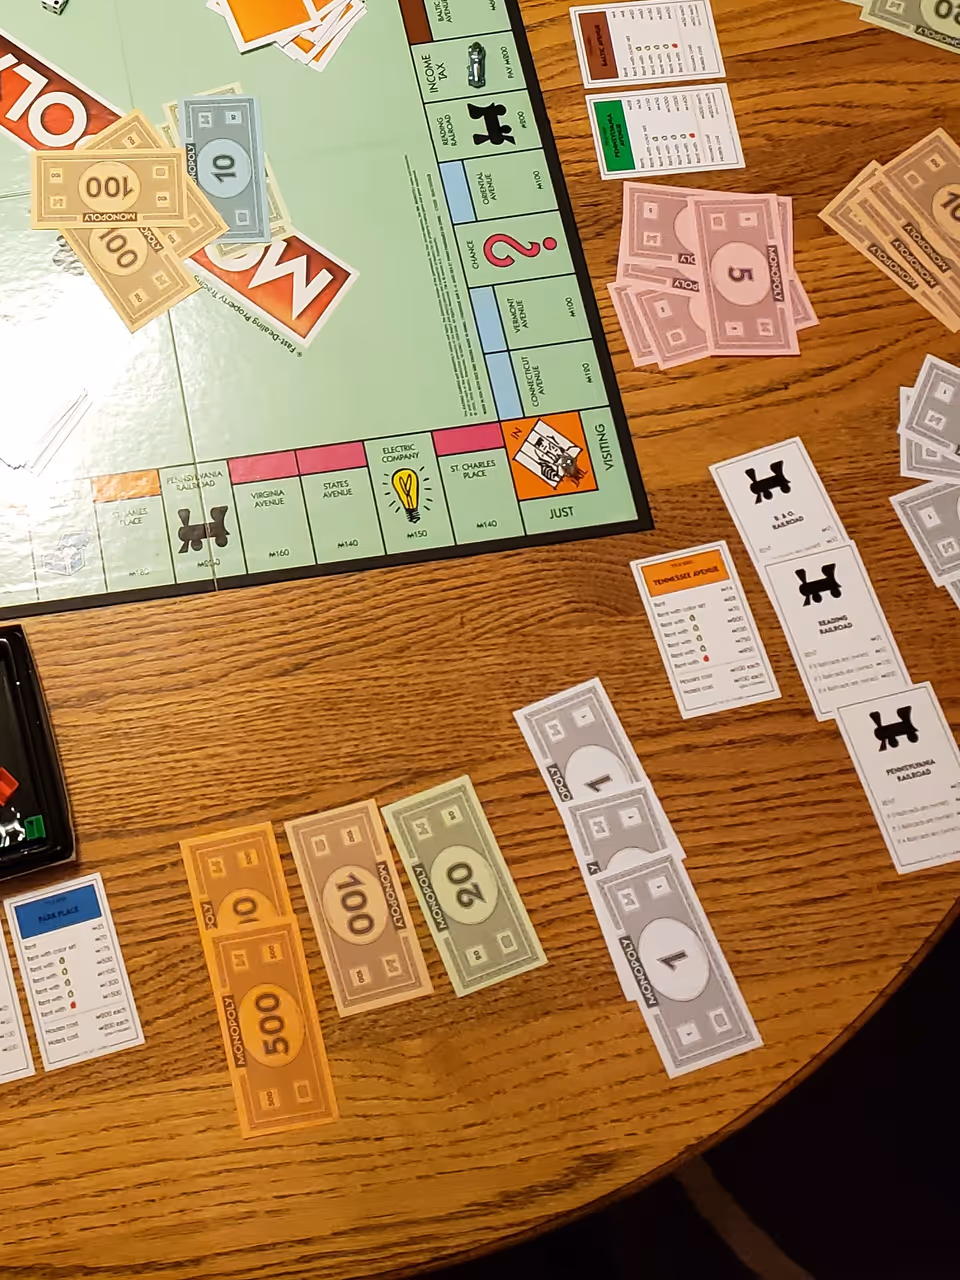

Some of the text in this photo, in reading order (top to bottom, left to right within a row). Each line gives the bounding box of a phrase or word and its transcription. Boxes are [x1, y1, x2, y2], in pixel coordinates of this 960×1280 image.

[420, 54, 438, 94] INCOME
[436, 62, 448, 81] TAX
[436, 117, 449, 146] READING
[444, 114, 458, 146] RAILROAD
[210, 153, 236, 184] 10
[85, 175, 136, 199] 100
[476, 172, 490, 205] ORIENTAL
[485, 173, 498, 200] AVENUE
[83, 212, 137, 222] MONOPOLY
[466, 240, 480, 270] CHANCE
[902, 222, 951, 273] MONOPOLY
[728, 266, 753, 282] 5
[767, 245, 785, 302] MONOPOLY
[867, 244, 919, 289] MONOPOLY
[891, 238, 937, 289] MONOPOLY
[219, 295, 252, 322] Property
[507, 298, 521, 334] VERMONT
[516, 300, 529, 328] AVENUE
[252, 317, 296, 353] Fast-Dealing
[521, 356, 540, 407] CONNECTICUT
[532, 364, 546, 396] AVENUE
[381, 452, 420, 464] COMPANY
[382, 444, 416, 454] ELECTRIC
[594, 423, 614, 471] VISITING
[450, 460, 496, 472] ST. CHARLES
[463, 470, 487, 479] PLACE
[250, 489, 286, 501] VIRGINIA
[322, 487, 353, 499] AVENUE
[323, 479, 349, 489] STATES
[254, 497, 285, 509] AVENUE
[549, 506, 574, 520] JUST
[583, 773, 613, 793] 1
[377, 861, 406, 930] MONOPOLY
[412, 863, 447, 932] MONOPOLY
[446, 861, 487, 909] 20
[335, 872, 376, 935] 100
[619, 936, 659, 1008] MONOPOLY
[656, 949, 689, 971] 1
[222, 995, 246, 1068] MONOPOLY
[255, 991, 290, 1057] 500
